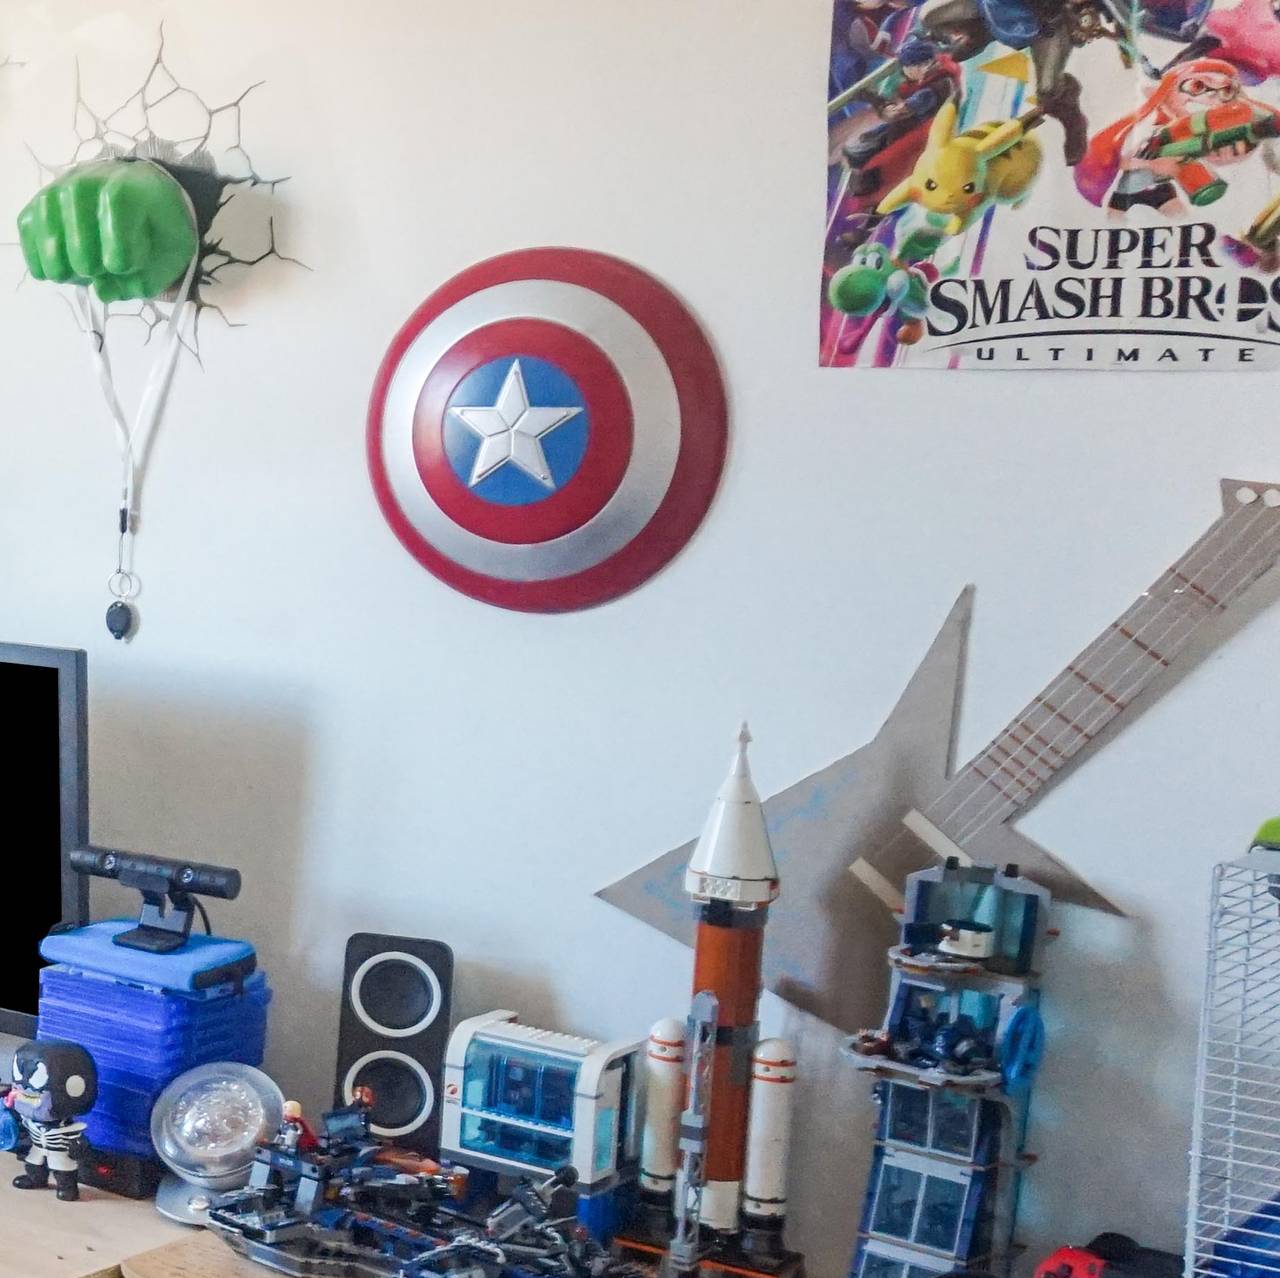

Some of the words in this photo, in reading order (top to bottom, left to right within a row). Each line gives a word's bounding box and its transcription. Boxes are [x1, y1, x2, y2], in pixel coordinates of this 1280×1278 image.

[1024, 221, 1223, 272] SUPER
[925, 276, 1125, 337] SMASH
[975, 347, 1256, 363] ULTIMATE
